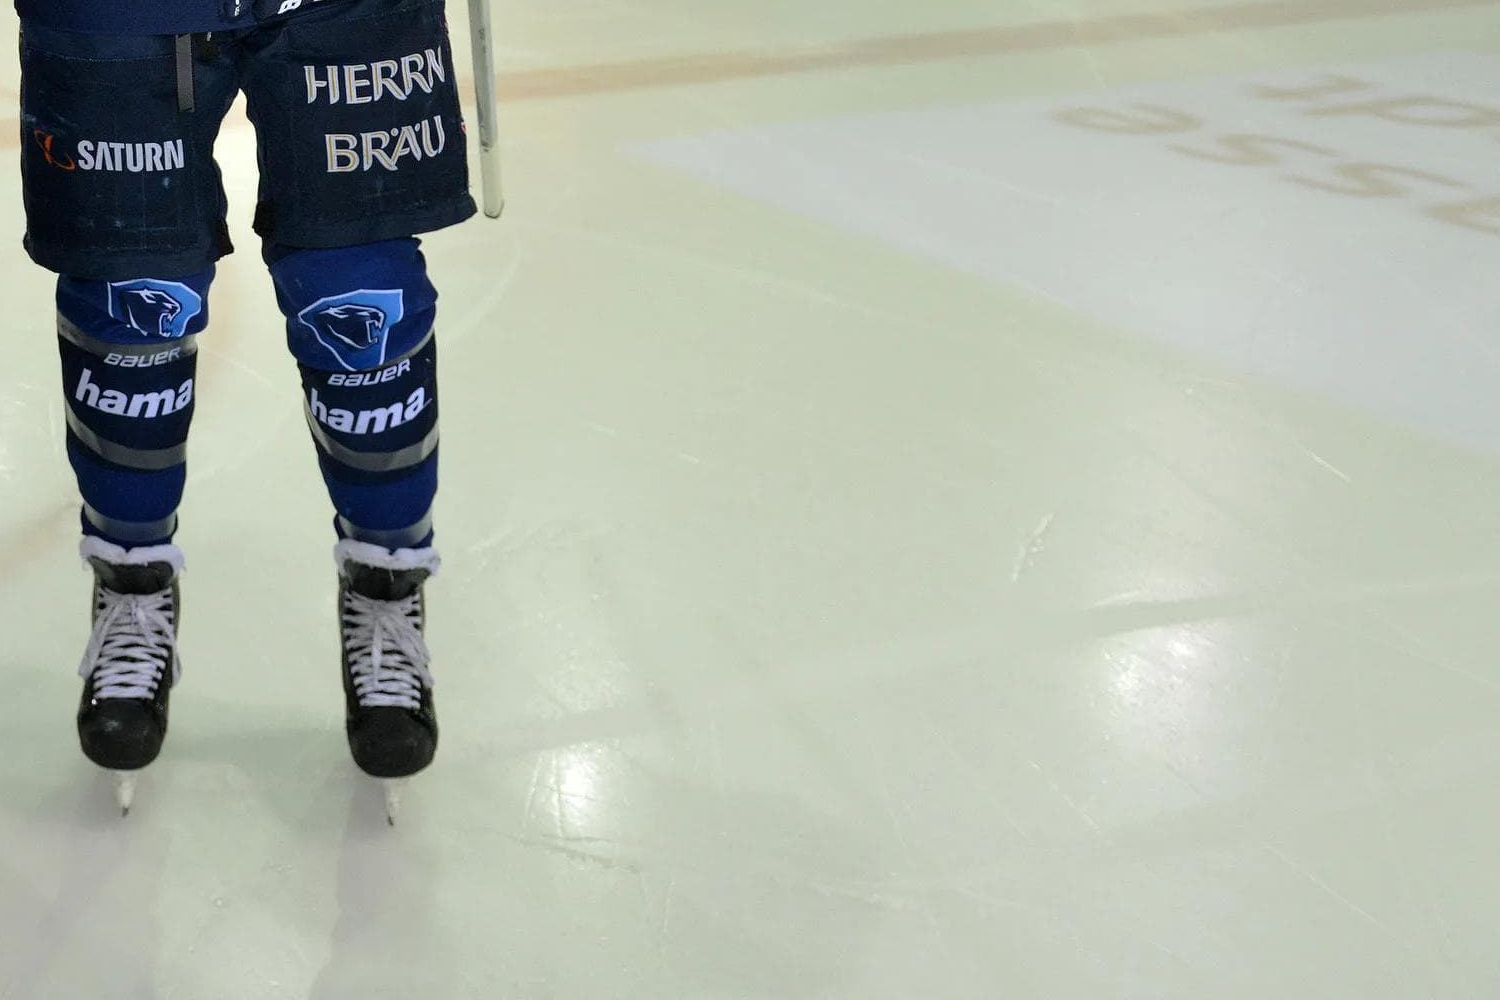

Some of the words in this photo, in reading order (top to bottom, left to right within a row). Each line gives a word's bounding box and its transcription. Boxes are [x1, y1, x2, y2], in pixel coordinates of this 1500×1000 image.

[304, 45, 445, 104] HERRN
[77, 139, 185, 173] SATURN
[325, 115, 446, 173] BRÄU
[103, 347, 180, 368] BAUER
[327, 359, 412, 388] BAUER
[75, 367, 195, 418] hama
[311, 386, 432, 434] hama
